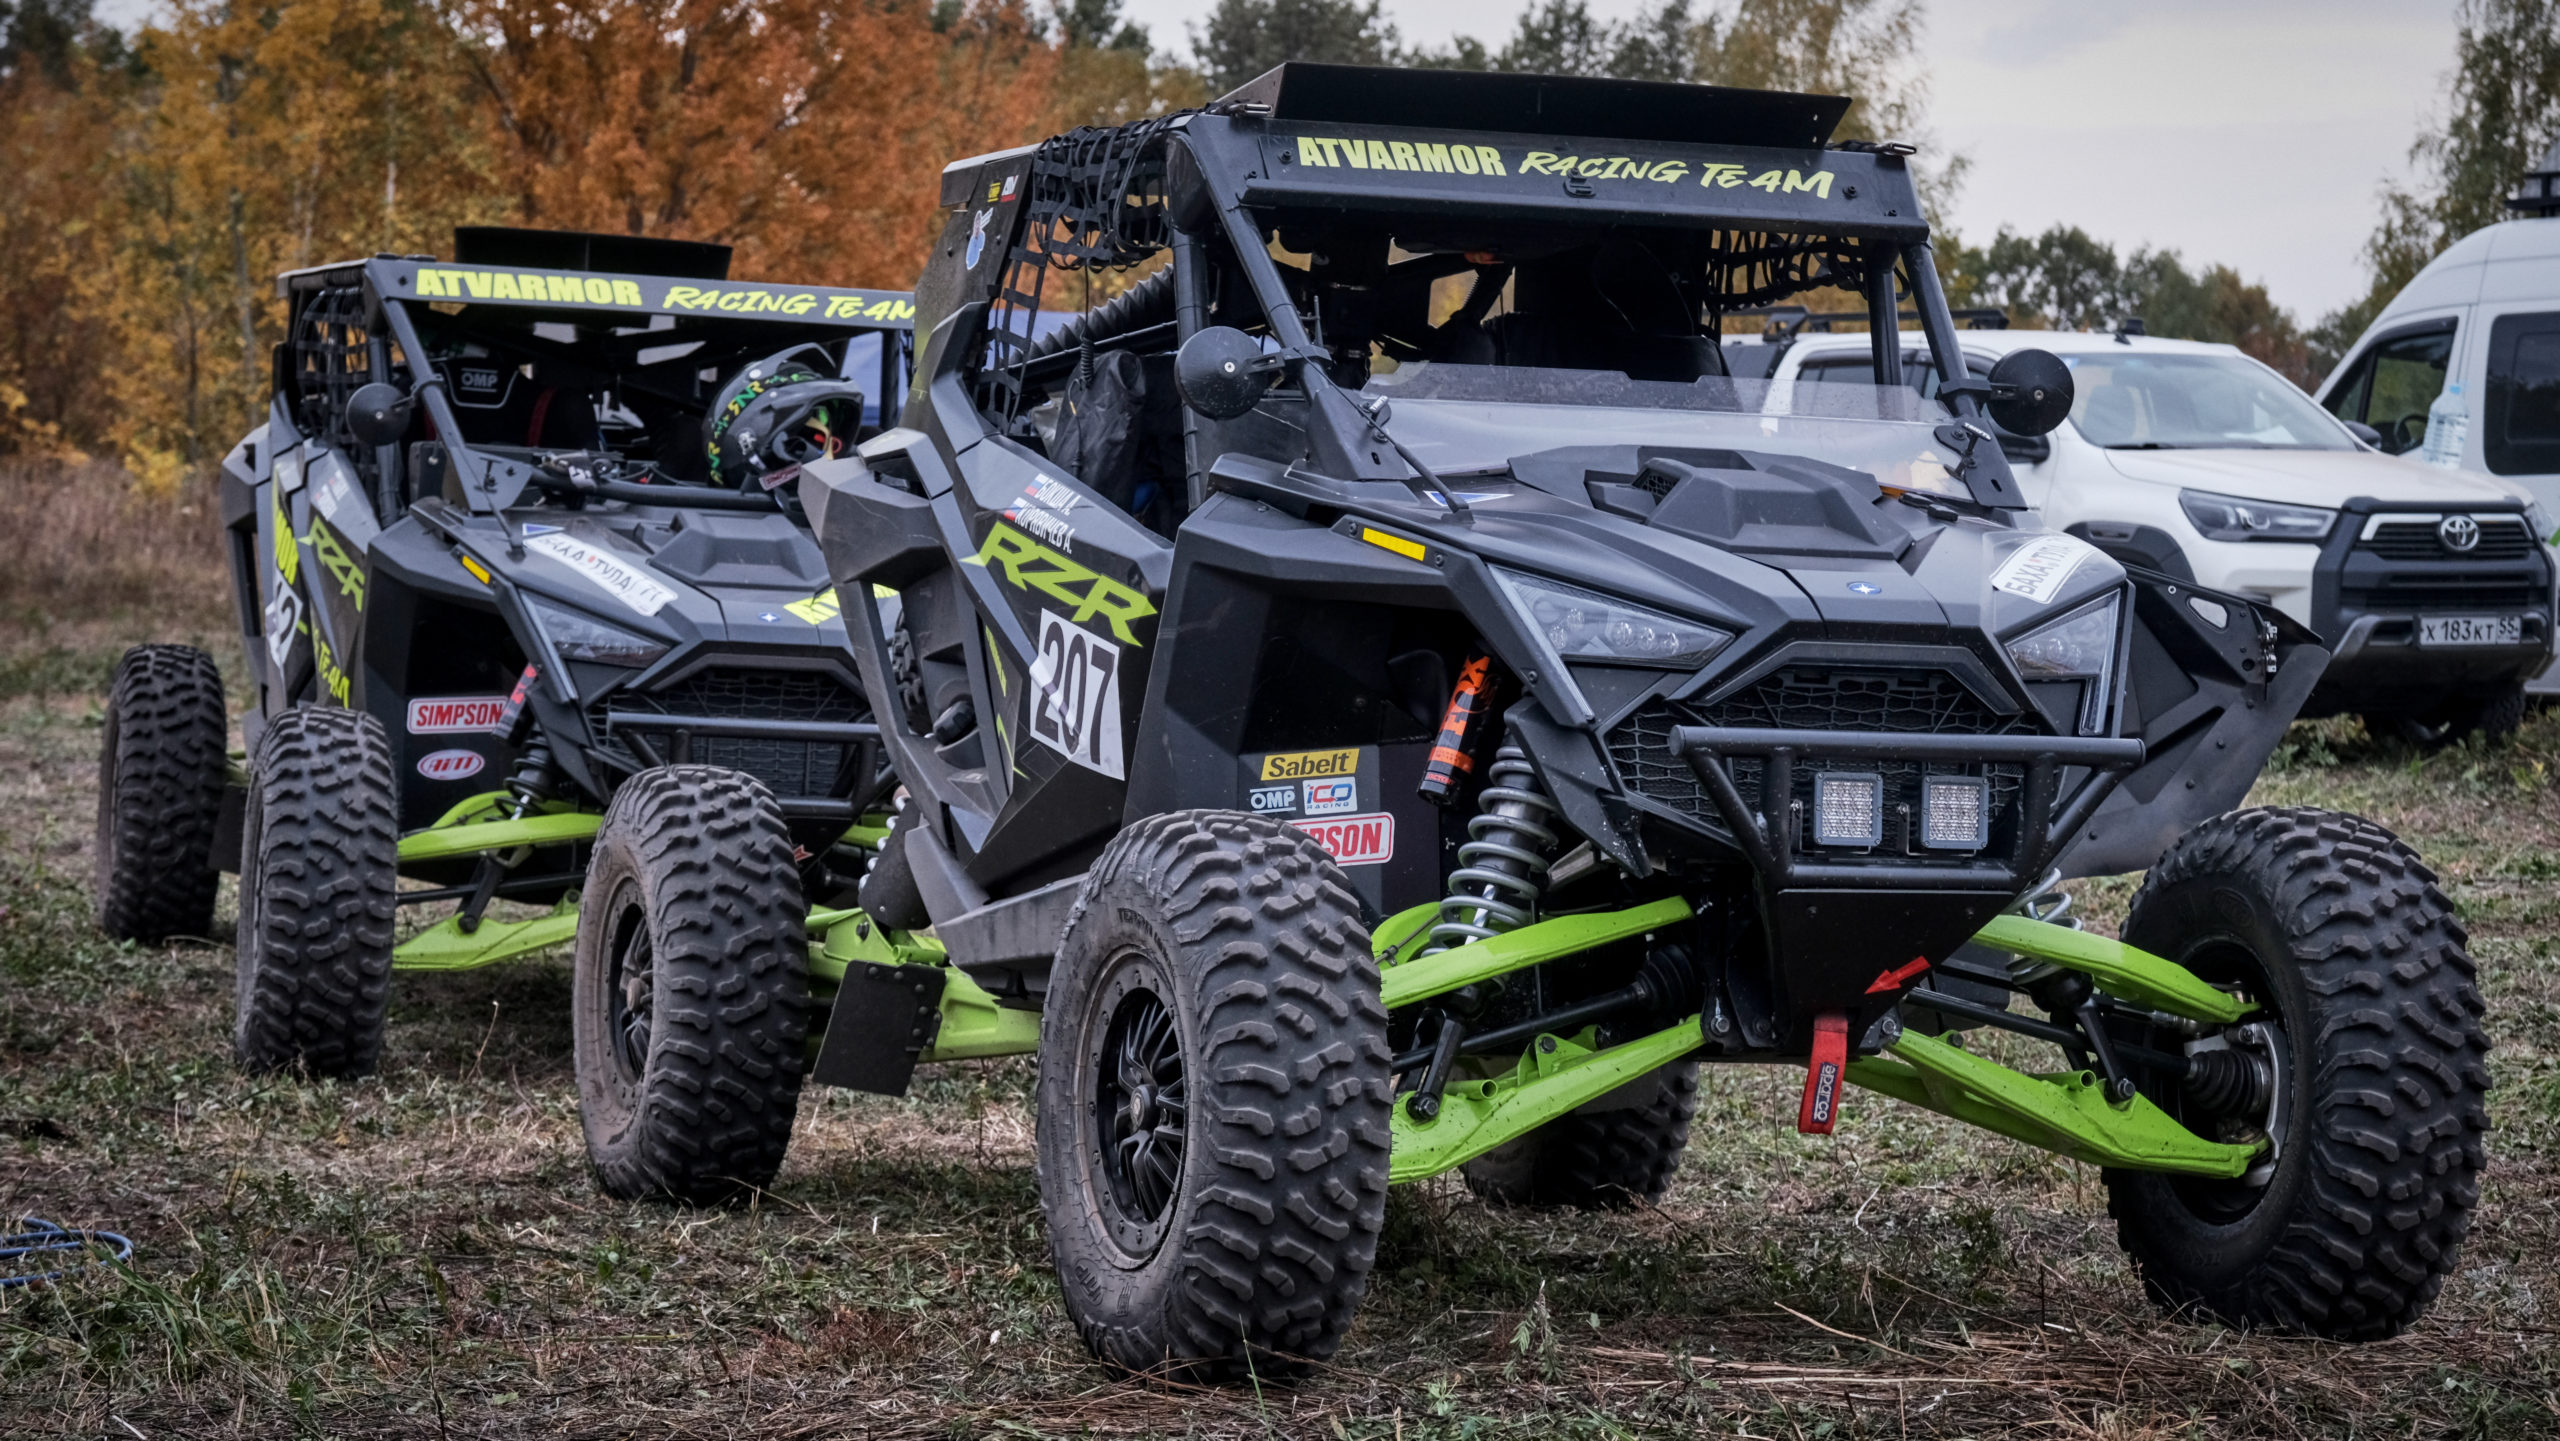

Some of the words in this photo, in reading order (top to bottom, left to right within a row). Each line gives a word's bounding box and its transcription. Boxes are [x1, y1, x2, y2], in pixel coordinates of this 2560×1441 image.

[1297, 136, 1507, 176] ATVARMOR
[1518, 151, 1690, 184] RACING
[1700, 162, 1834, 199] TEAM
[416, 269, 642, 306] ATVARMOR
[662, 286, 818, 315] RACING
[461, 372, 498, 388] OMP
[960, 521, 1158, 648] RZR
[2004, 564, 2053, 595] БАХА
[1035, 620, 1116, 767] 207
[1439, 655, 1491, 736] FOX
[416, 703, 503, 727] SIMPSON
[1268, 752, 1350, 778] Sabelt
[1250, 790, 1296, 809] OMP
[1306, 801, 1350, 810] RACING
